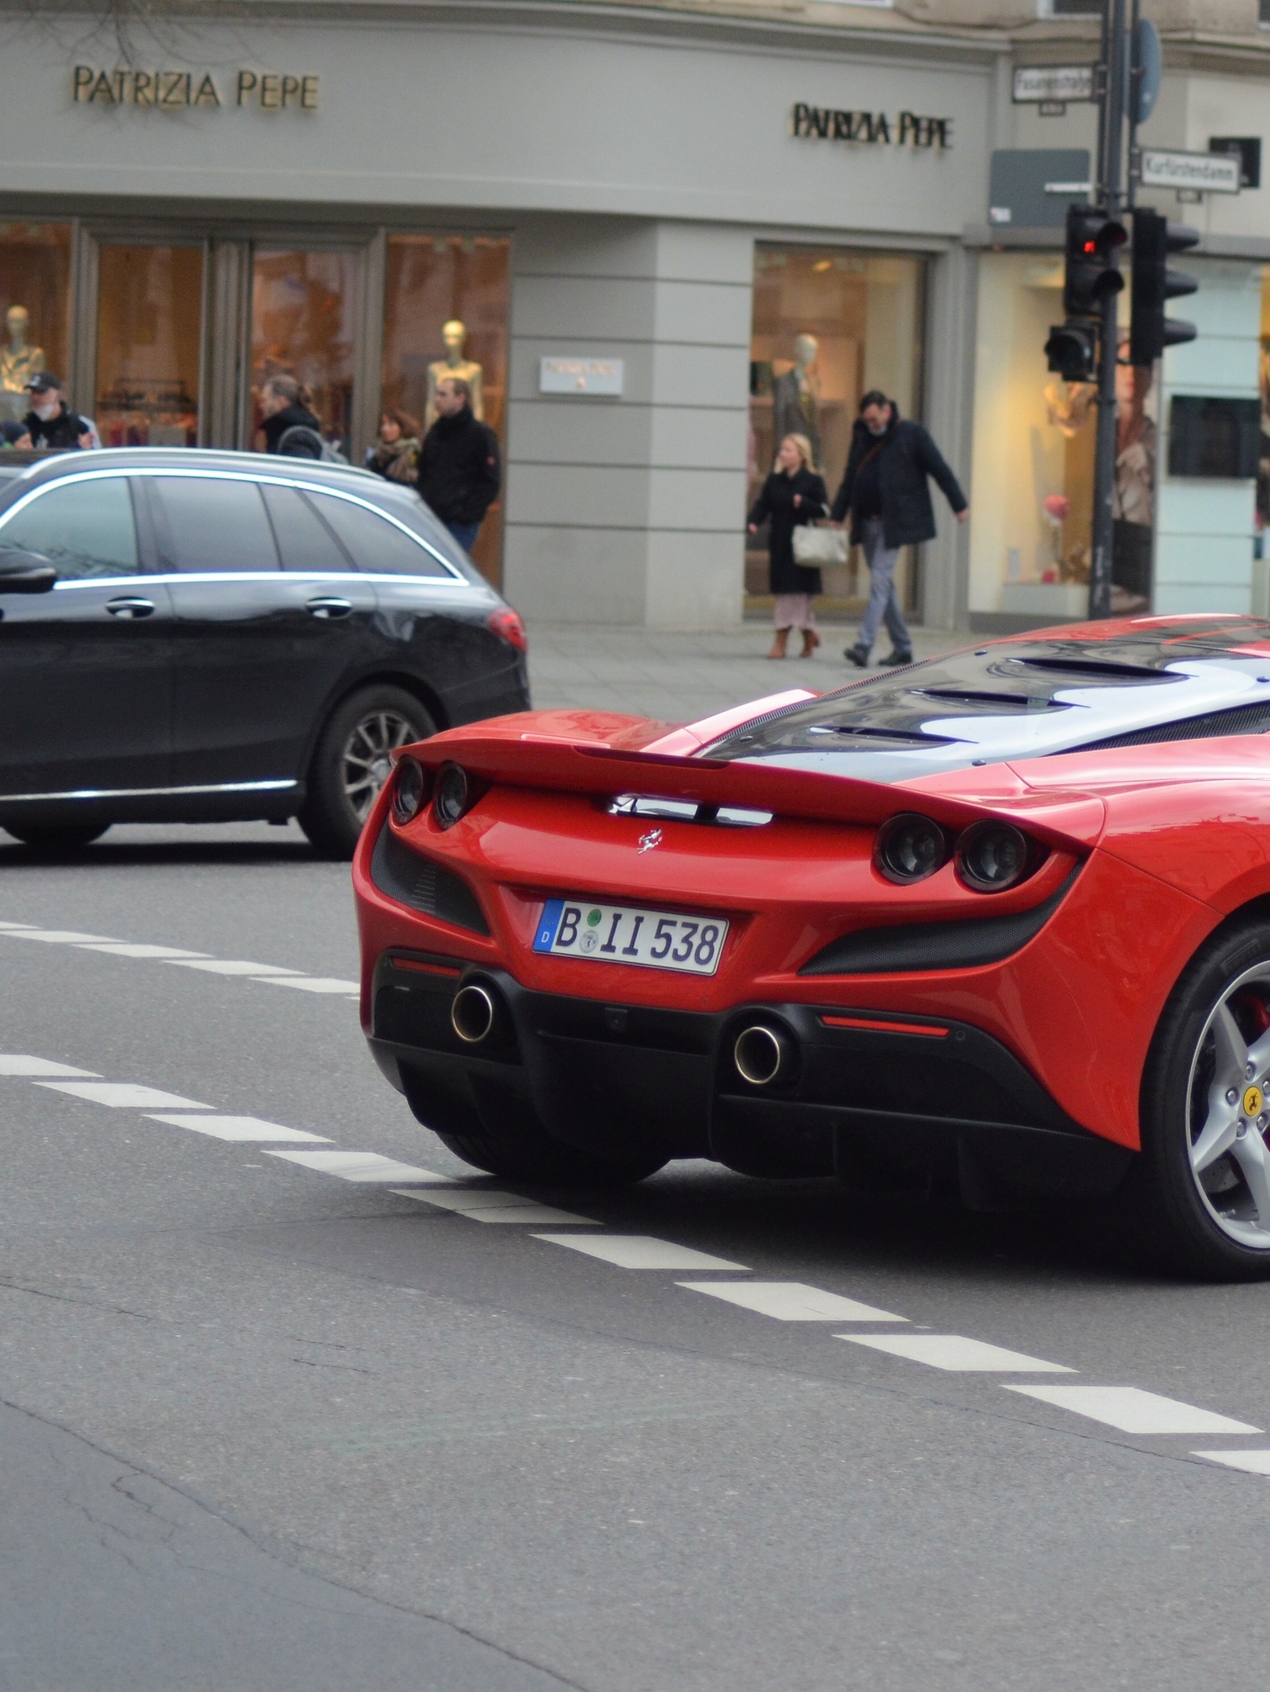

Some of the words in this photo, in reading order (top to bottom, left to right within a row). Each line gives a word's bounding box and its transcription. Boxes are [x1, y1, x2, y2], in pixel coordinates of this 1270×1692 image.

[73, 65, 220, 106] PATRIZIA
[237, 70, 319, 110] PEPE
[900, 110, 953, 149] PEPE
[541, 931, 550, 943] D
[555, 907, 581, 947] B
[650, 919, 719, 966] 538
